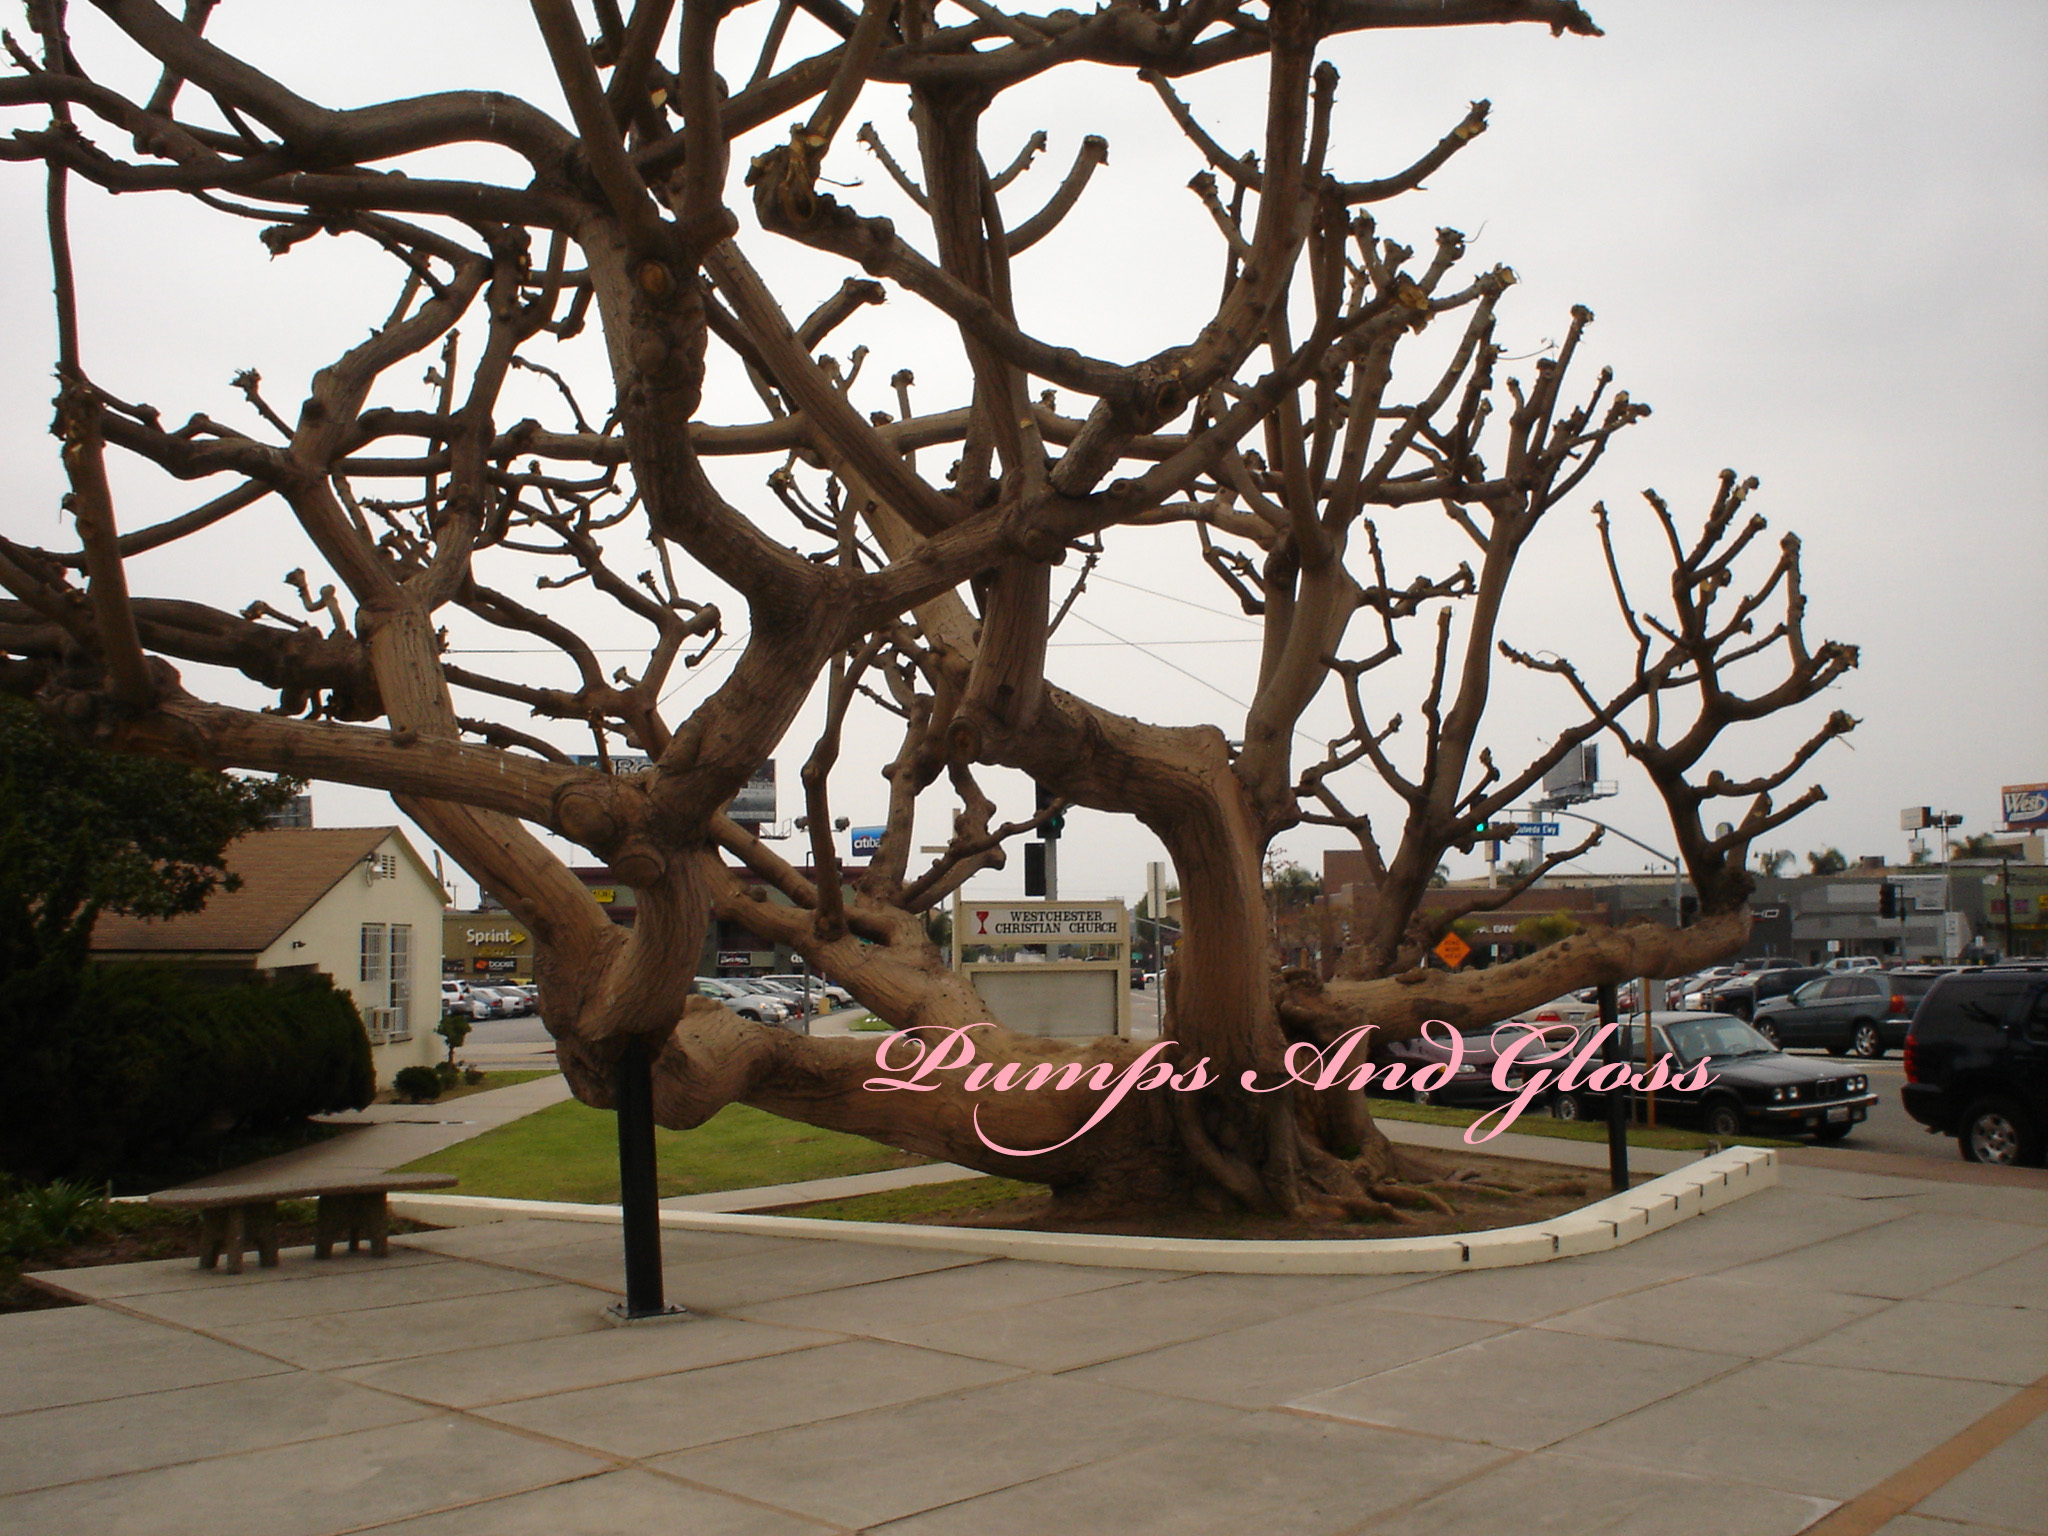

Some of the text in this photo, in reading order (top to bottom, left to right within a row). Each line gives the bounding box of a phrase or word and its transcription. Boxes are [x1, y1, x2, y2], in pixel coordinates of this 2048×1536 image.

[1010, 910, 1103, 922] WESTCHESTER
[995, 921, 1118, 935] CHRISTIAN CHURCH
[466, 928, 512, 946] Sprint
